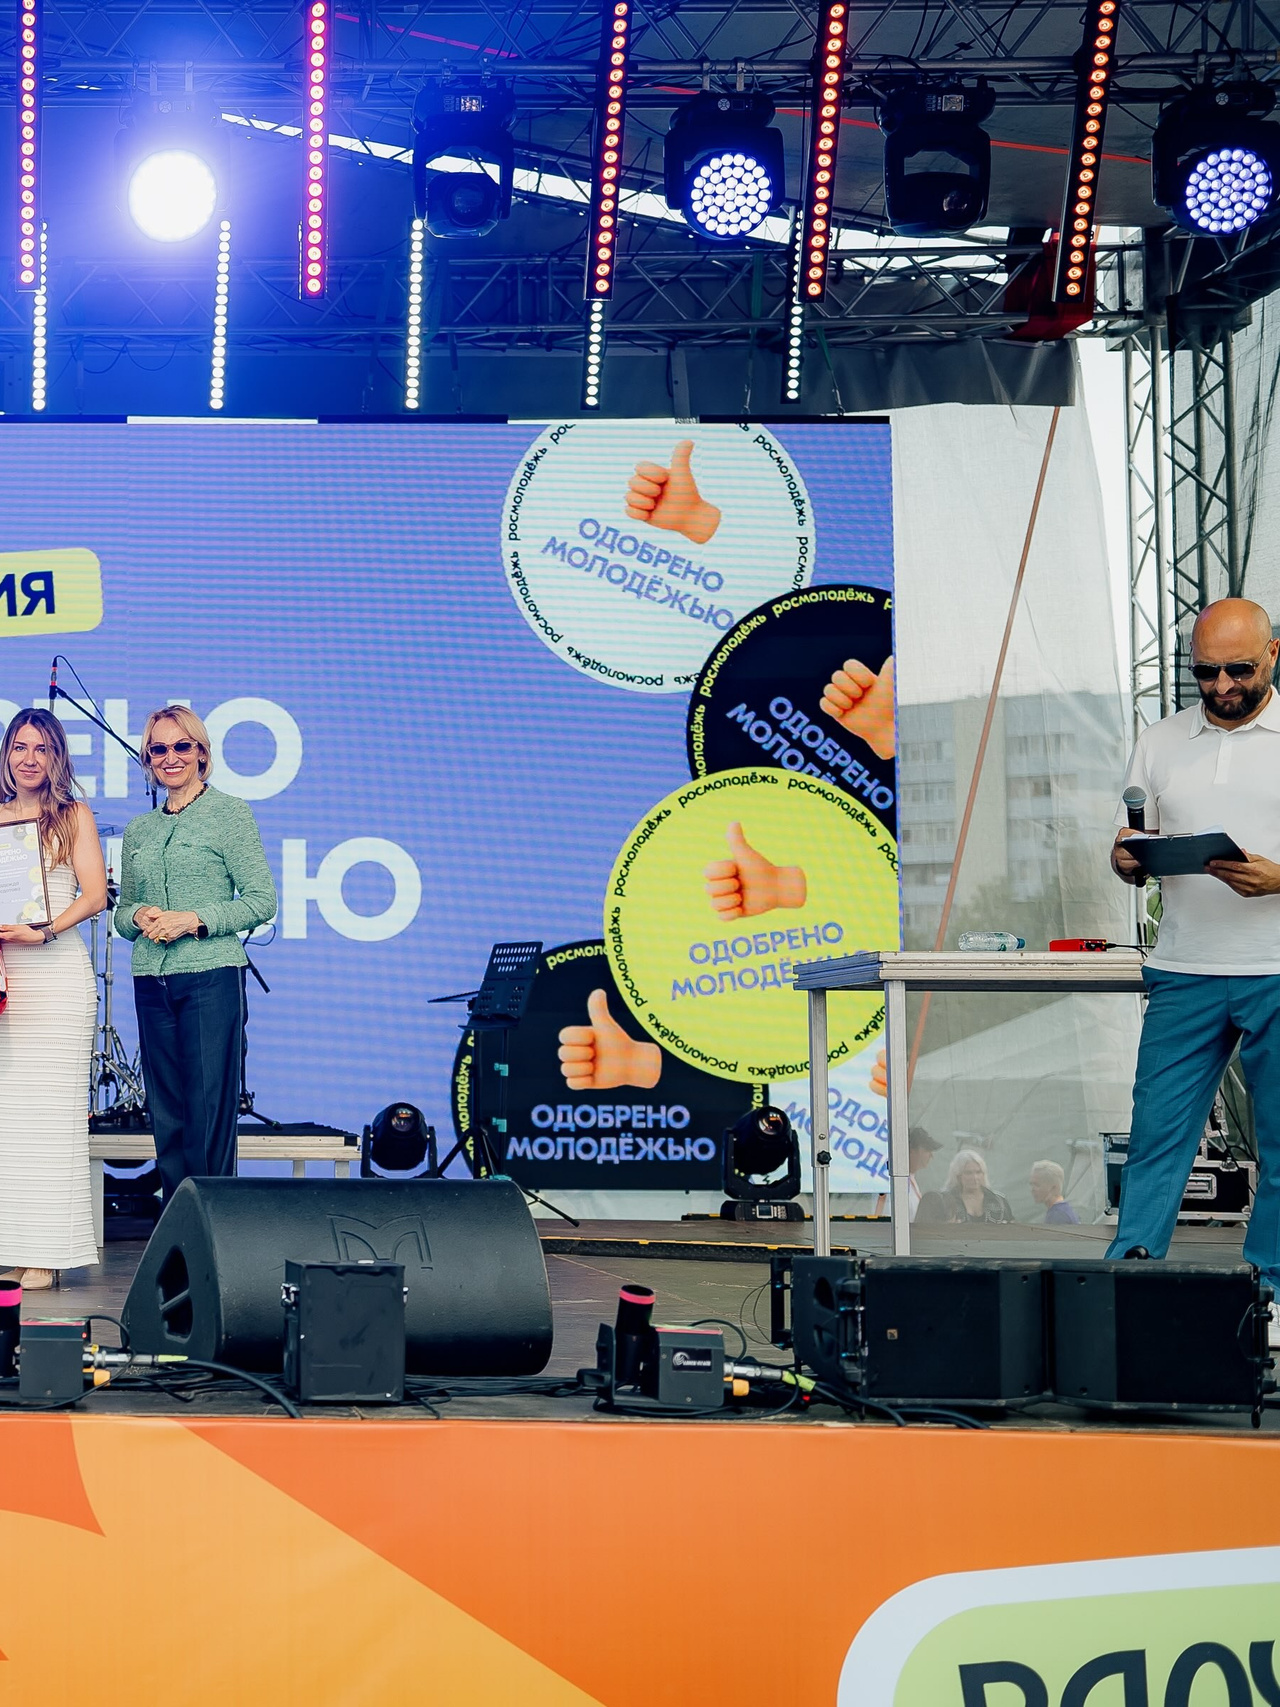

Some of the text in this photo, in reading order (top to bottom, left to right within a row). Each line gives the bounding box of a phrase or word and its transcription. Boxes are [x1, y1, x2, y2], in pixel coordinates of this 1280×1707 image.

[509, 435, 808, 686] росмолодёжь росмолодёжь росмол росмолодёжь росмолодёжь
[541, 536, 734, 631] МОЛОДЁЖЬЮ
[579, 518, 724, 592] ОДОБРЕНО
[700, 615, 767, 698] росмолодёжь
[772, 588, 875, 617] росмолодёжь
[769, 696, 894, 810] ОДОБРЕНО
[678, 774, 778, 808] росмолодёжь
[788, 778, 878, 838] росмолодёжь
[614, 808, 672, 897] росмолодёжь
[608, 906, 648, 1007] росмолодёжь
[671, 950, 870, 1001] МОЛОДЁ
[689, 922, 843, 966] ОДОБРЕНО
[648, 1012, 738, 1073] росмолодёжь
[506, 1132, 716, 1164] МОЛОДЁЖЬЮ
[531, 1103, 690, 1132] ОДОБРЕНО
